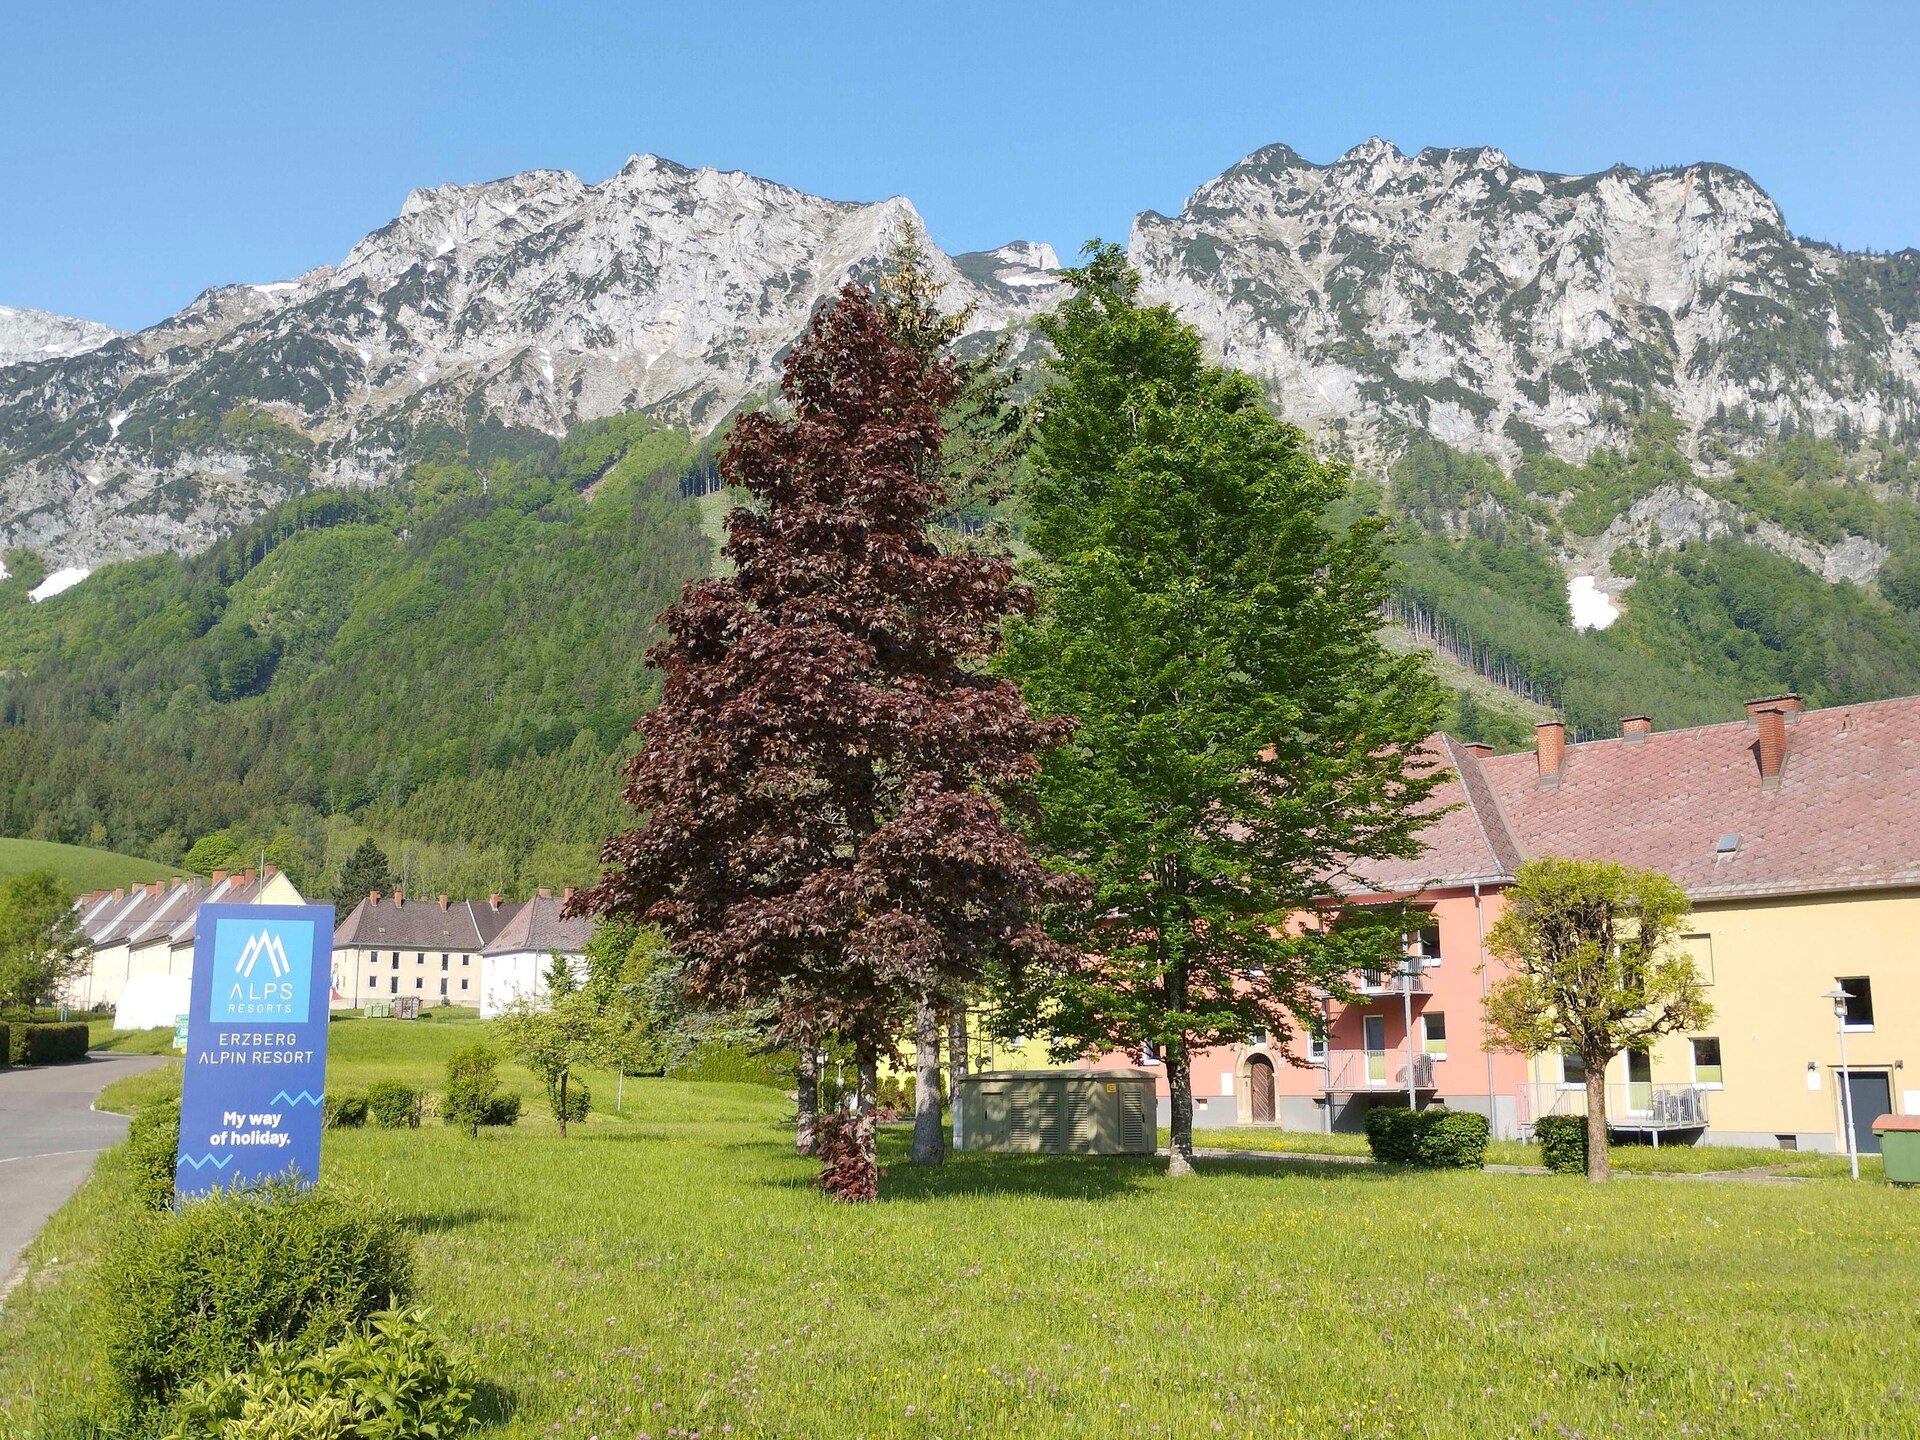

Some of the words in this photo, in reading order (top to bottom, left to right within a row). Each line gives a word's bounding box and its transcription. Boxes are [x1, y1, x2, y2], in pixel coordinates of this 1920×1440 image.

[229, 982, 293, 1000] ALPS
[228, 1004, 292, 1014] RESORTS
[219, 1033, 296, 1046] ERZBERG
[198, 1051, 247, 1064] ALPIN
[252, 1051, 314, 1064] RESORT
[223, 1111, 247, 1129] My
[249, 1113, 282, 1128] way
[209, 1130, 228, 1146] of
[230, 1130, 291, 1148] holiday.
